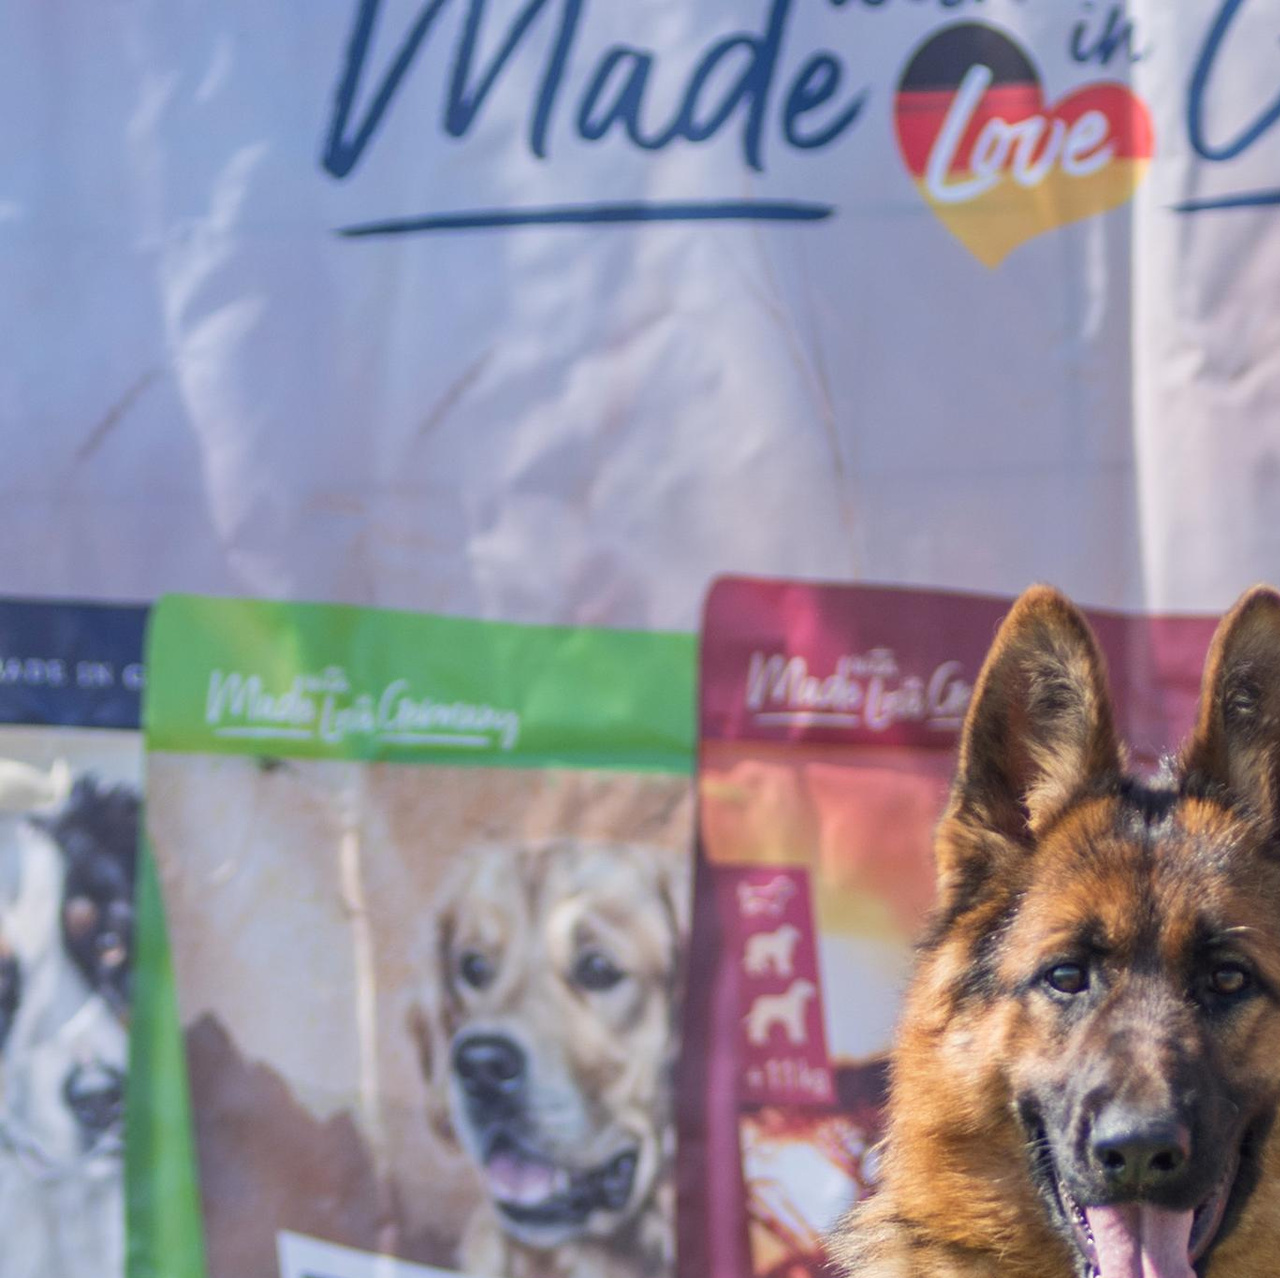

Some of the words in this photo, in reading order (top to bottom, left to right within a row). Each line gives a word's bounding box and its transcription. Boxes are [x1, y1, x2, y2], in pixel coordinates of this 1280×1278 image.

[322, 0, 866, 178] Made
[929, 64, 1119, 200] Love
[1068, 2, 1148, 66] in
